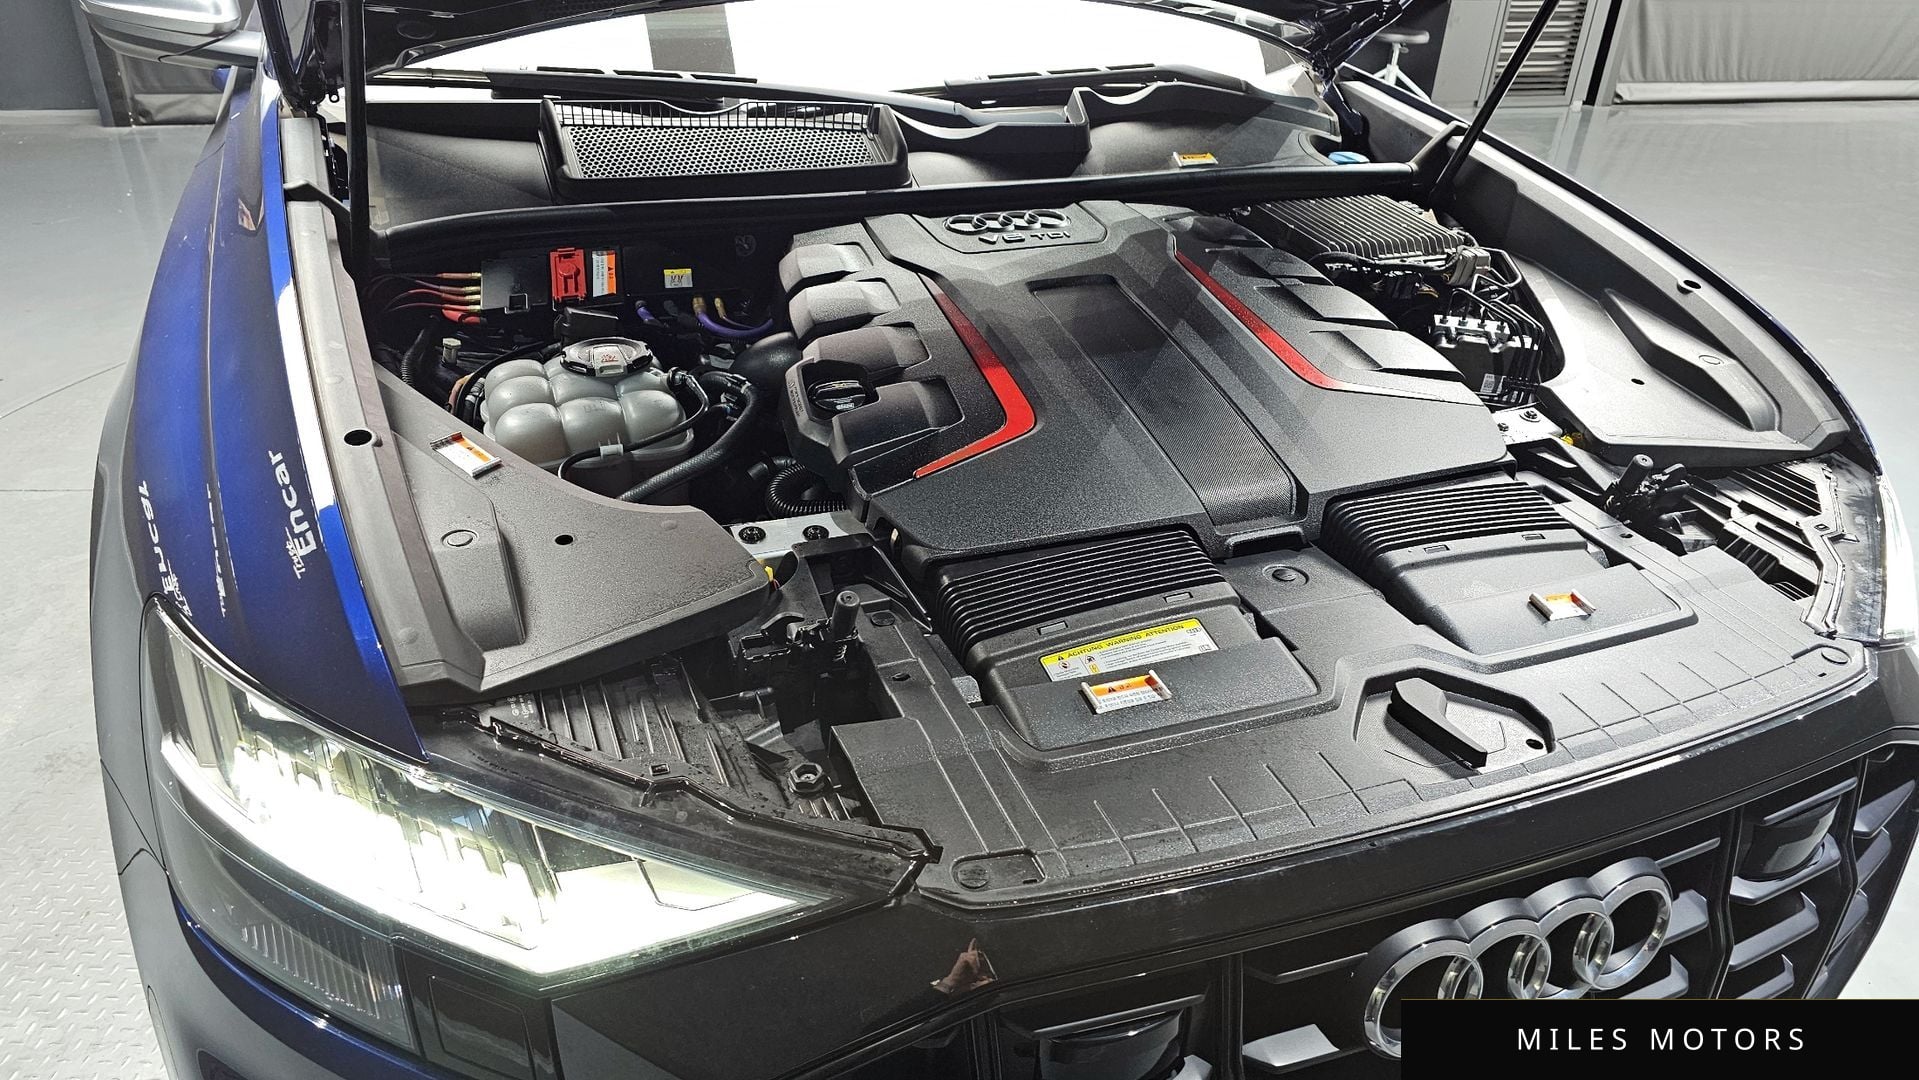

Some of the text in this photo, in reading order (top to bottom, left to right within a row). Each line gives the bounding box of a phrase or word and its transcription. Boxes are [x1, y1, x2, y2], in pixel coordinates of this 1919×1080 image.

[1030, 230, 1070, 240] TDI
[268, 450, 317, 557] Encar
[1067, 644, 1104, 658] ACHTUNG
[1106, 634, 1142, 647] WARNING
[1145, 624, 1185, 637] ATTENTION
